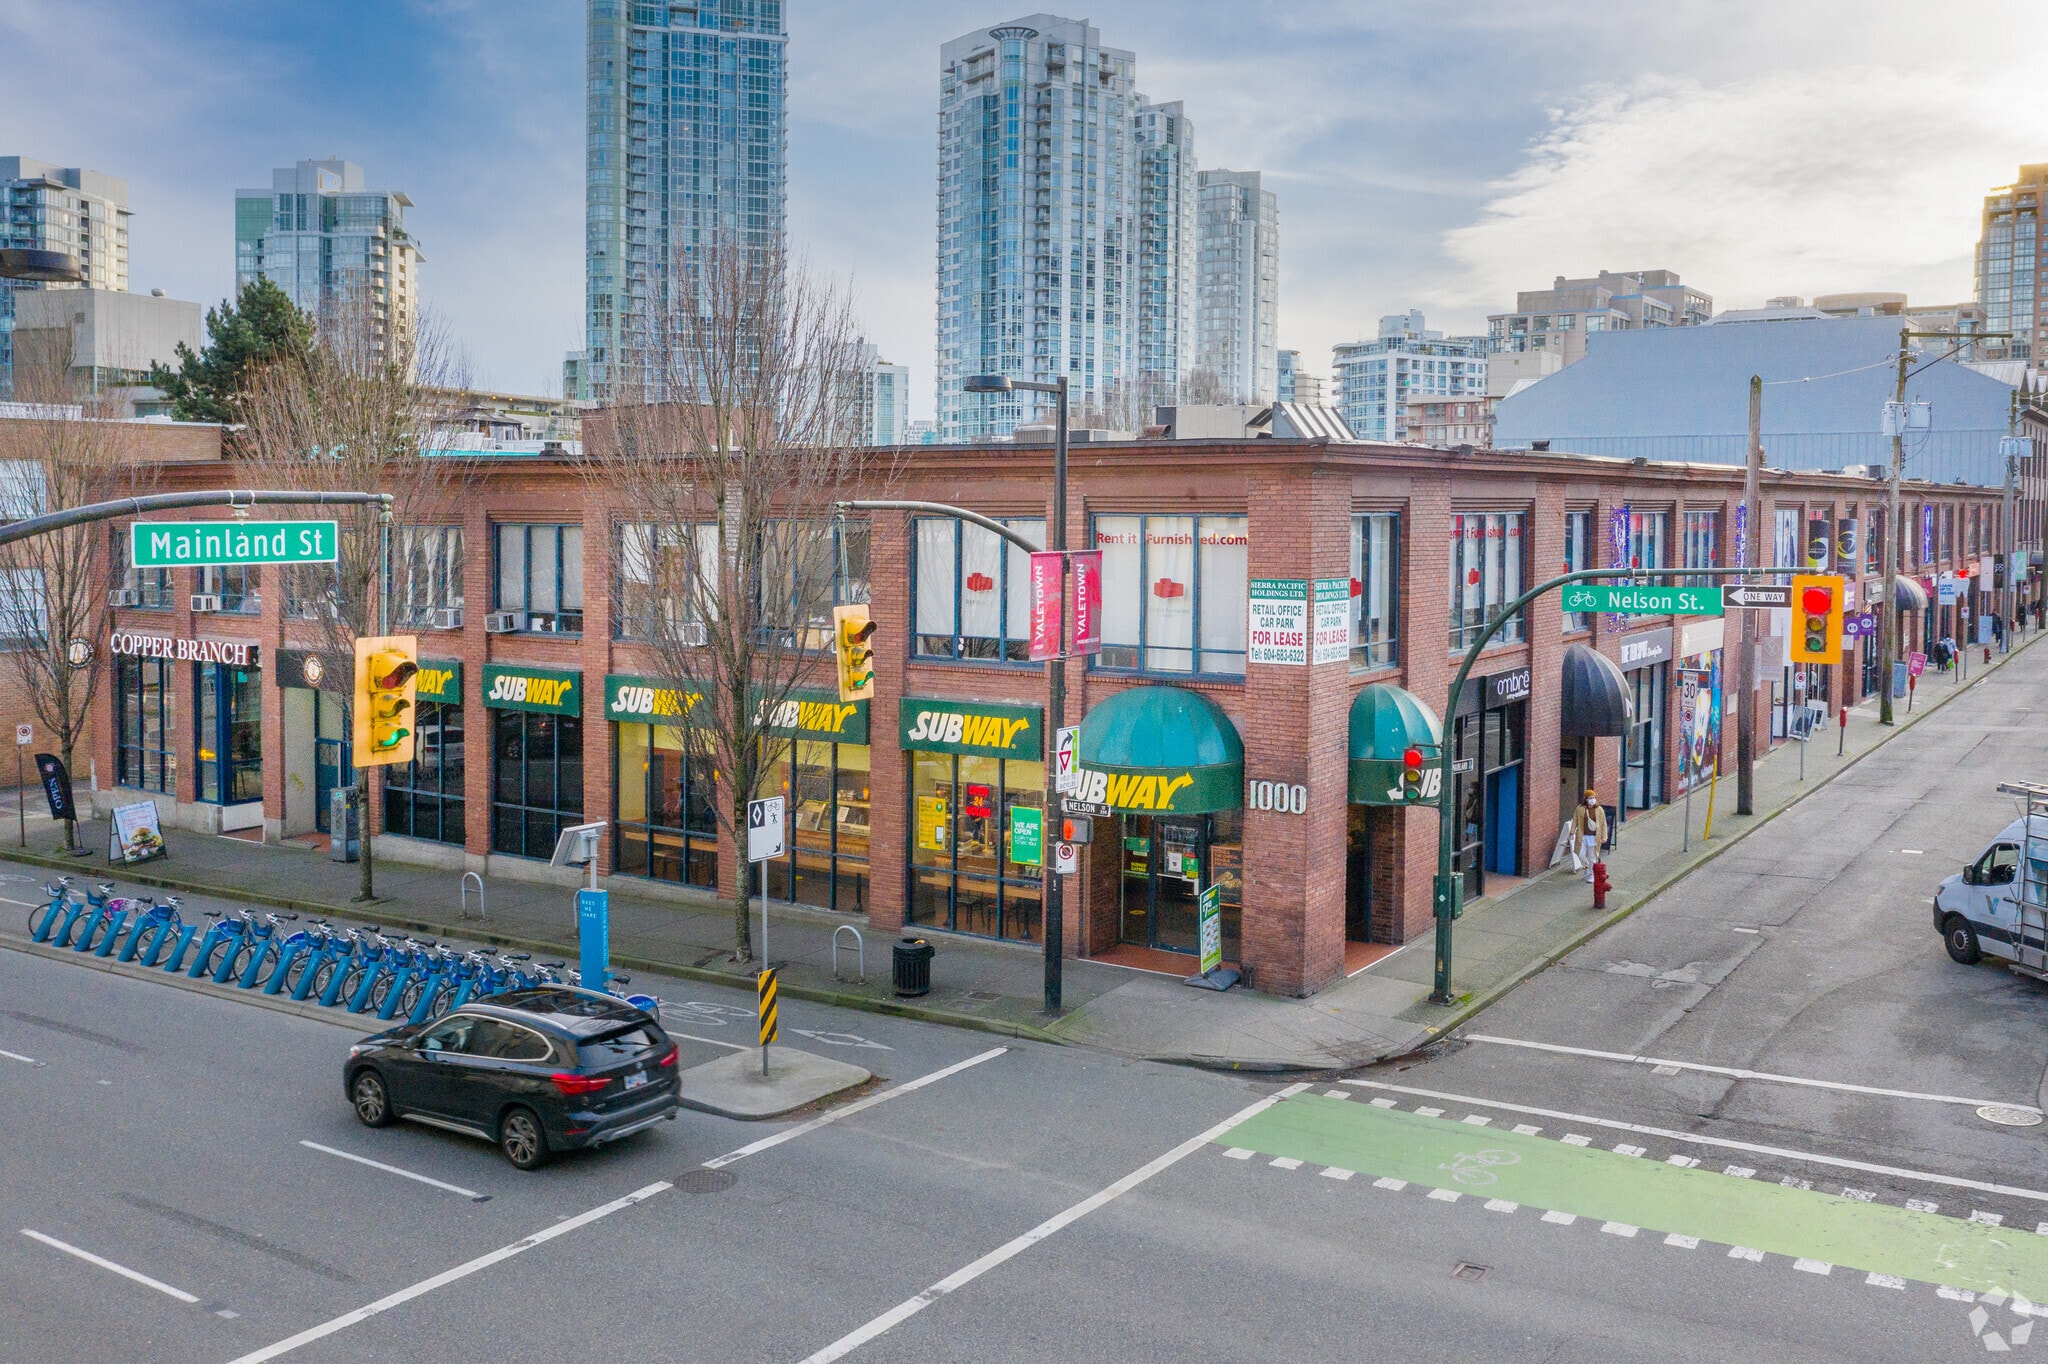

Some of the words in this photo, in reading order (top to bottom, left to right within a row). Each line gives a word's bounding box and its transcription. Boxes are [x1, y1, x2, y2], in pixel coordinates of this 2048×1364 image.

[151, 529, 286, 559] Mainland
[299, 529, 323, 556] St
[1096, 533, 1124, 544] Rent
[1128, 533, 1137, 544] it
[1250, 581, 1277, 589] SIERRA
[1278, 582, 1306, 590] PACIFIC
[1077, 563, 1087, 636] YALETOWN
[1251, 589, 1288, 597] HOLDINGS
[1290, 590, 1306, 598] LTD.
[1608, 591, 1672, 609] Nelson
[1678, 593, 1705, 610] St.
[1743, 592, 1761, 601] ONE
[1764, 593, 1784, 601] WAY
[1035, 565, 1045, 641] YALETOWN
[1252, 604, 1276, 616] RETAIL
[1316, 604, 1331, 616] RETAIL
[1260, 617, 1274, 628] CAR
[1276, 618, 1295, 629] PARK
[1330, 616, 1342, 627] PARK
[1252, 631, 1271, 645] FOR
[1273, 632, 1303, 646] LEASE
[1316, 632, 1328, 646] FOR
[1328, 629, 1347, 644] LEASE
[110, 633, 175, 659] COPPER
[177, 638, 248, 666] BRANCH
[1251, 647, 1262, 660] Tel:
[415, 669, 453, 695] WAY
[1497, 671, 1530, 695] ombrê
[489, 675, 573, 706] SUBWAY
[1684, 682, 1696, 699] 30
[611, 686, 703, 717] SUBWAY
[750, 698, 858, 734] SUBWAY
[908, 711, 1031, 750] SUBWAY
[968, 785, 989, 797] OPEN
[1060, 781, 1077, 789] BICYCLES
[1067, 768, 1194, 810] UBWAY
[48, 777, 63, 810] OPEN
[973, 796, 983, 806] 24
[1249, 780, 1307, 815] 1000
[966, 806, 991, 818] HOURS
[1068, 801, 1096, 813] NELSON
[1014, 822, 1024, 830] WE
[1025, 823, 1039, 831] ARE
[1014, 828, 1032, 836] OPEN
